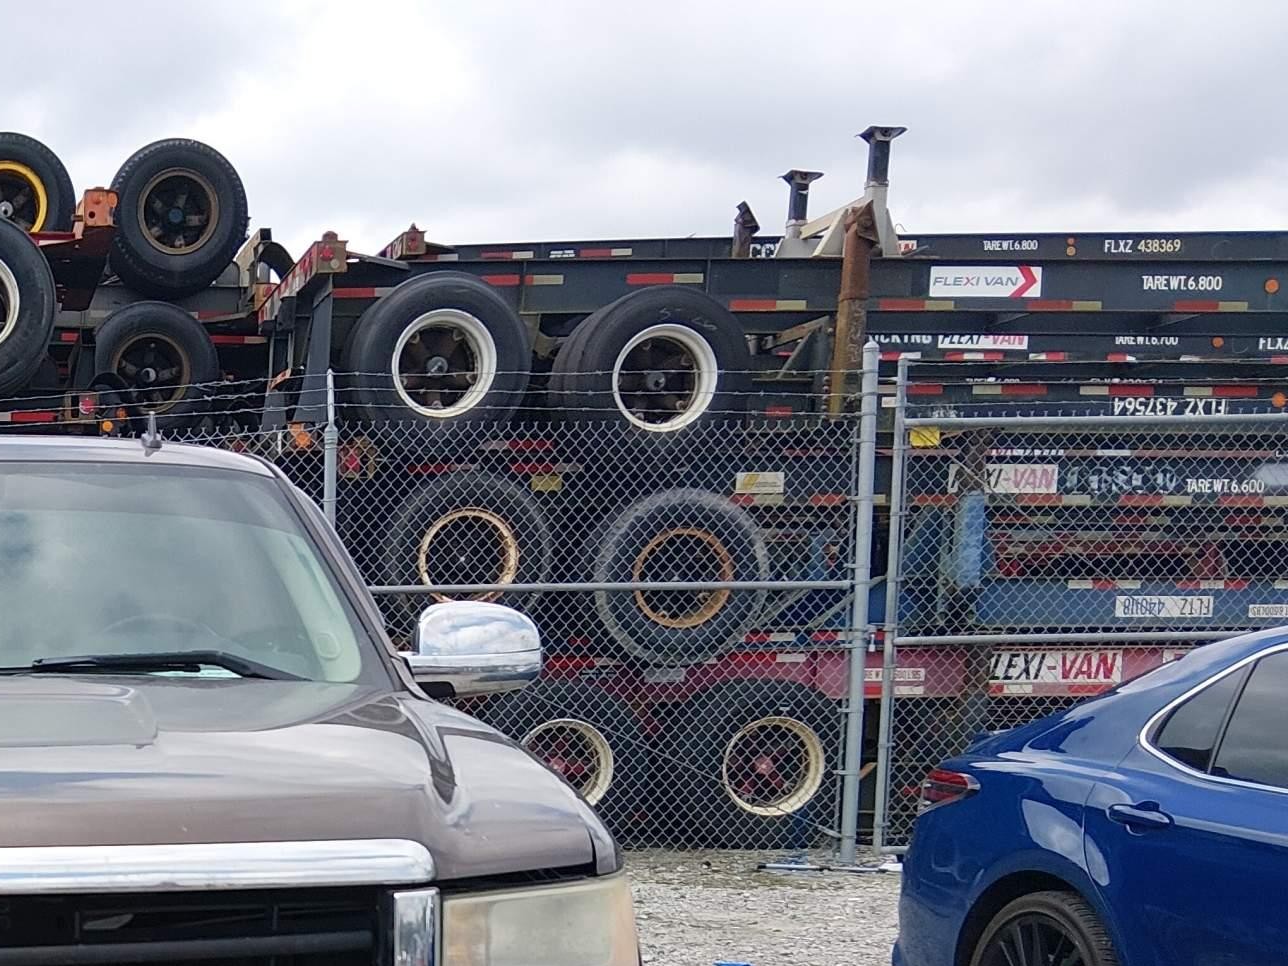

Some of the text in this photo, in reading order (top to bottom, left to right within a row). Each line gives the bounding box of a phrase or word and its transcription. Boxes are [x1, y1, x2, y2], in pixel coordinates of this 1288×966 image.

[1104, 239, 1181, 253] FLXZ 438369
[932, 276, 1020, 287] FLEXI VAN
[1142, 276, 1168, 290] TARE
[1113, 398, 1227, 416] FLXZ 437564
[1186, 479, 1212, 492] TARE
[1180, 598, 1211, 616] FLTZ
[991, 652, 1117, 680] LEXI-VAN
